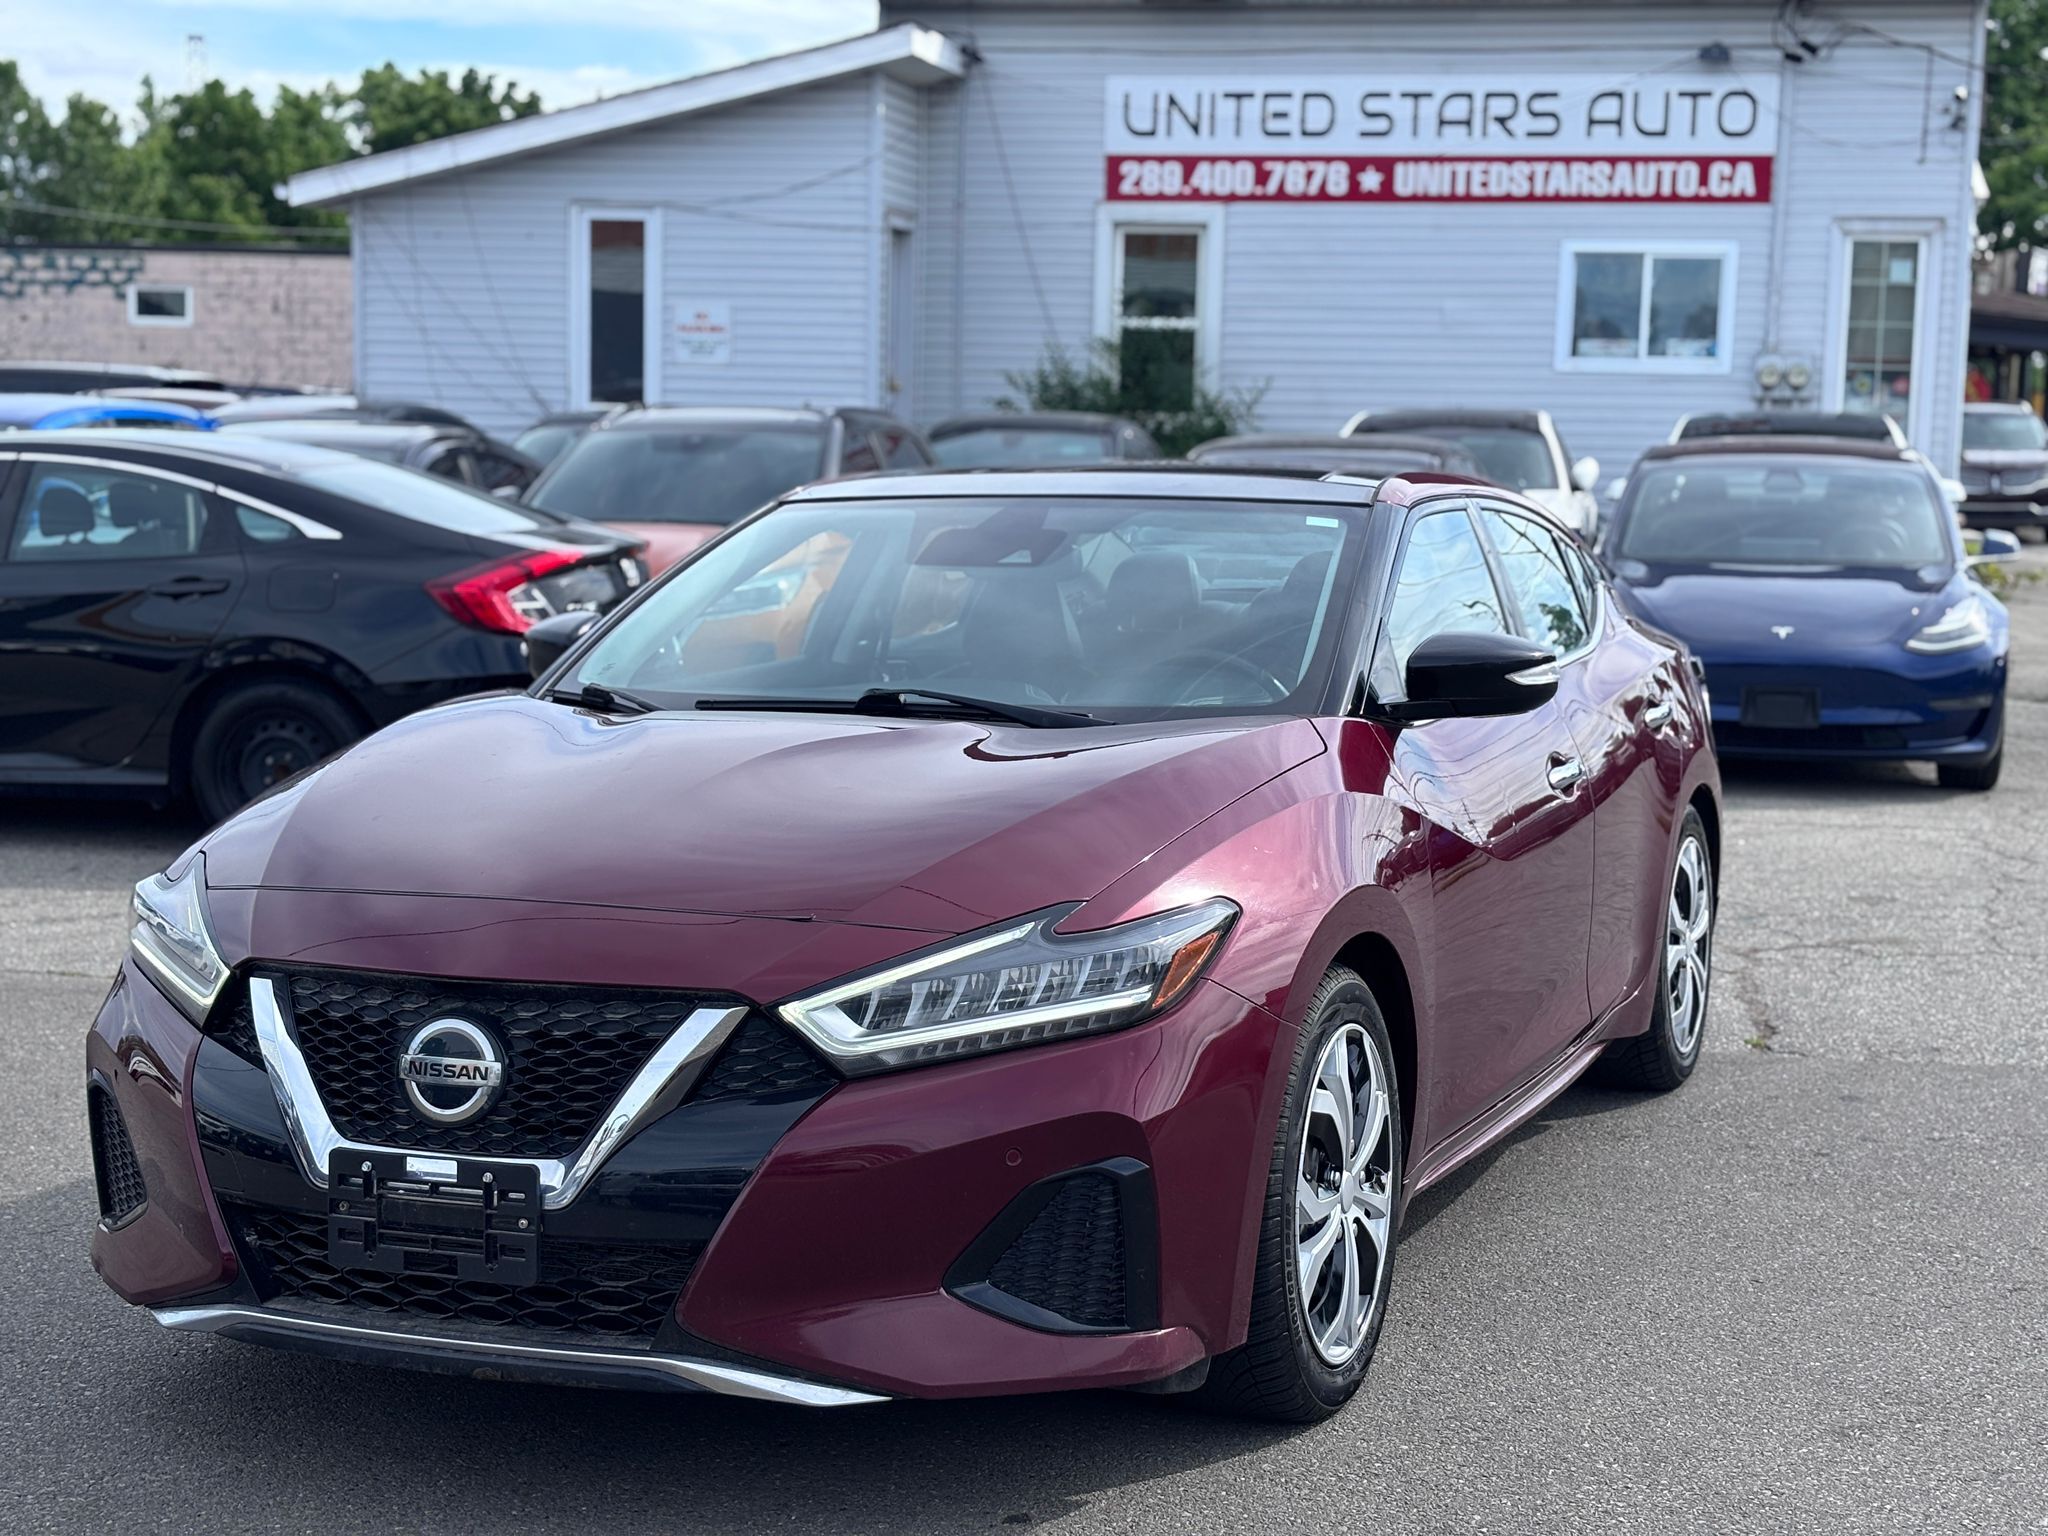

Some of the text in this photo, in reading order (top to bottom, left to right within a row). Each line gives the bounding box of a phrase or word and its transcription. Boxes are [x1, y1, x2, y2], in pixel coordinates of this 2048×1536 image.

[1123, 90, 1758, 138] UNITED STARS AUTO
[1392, 160, 1758, 199] UNITEDSTARSAUTO.CA
[407, 1060, 489, 1081] NISSAN
